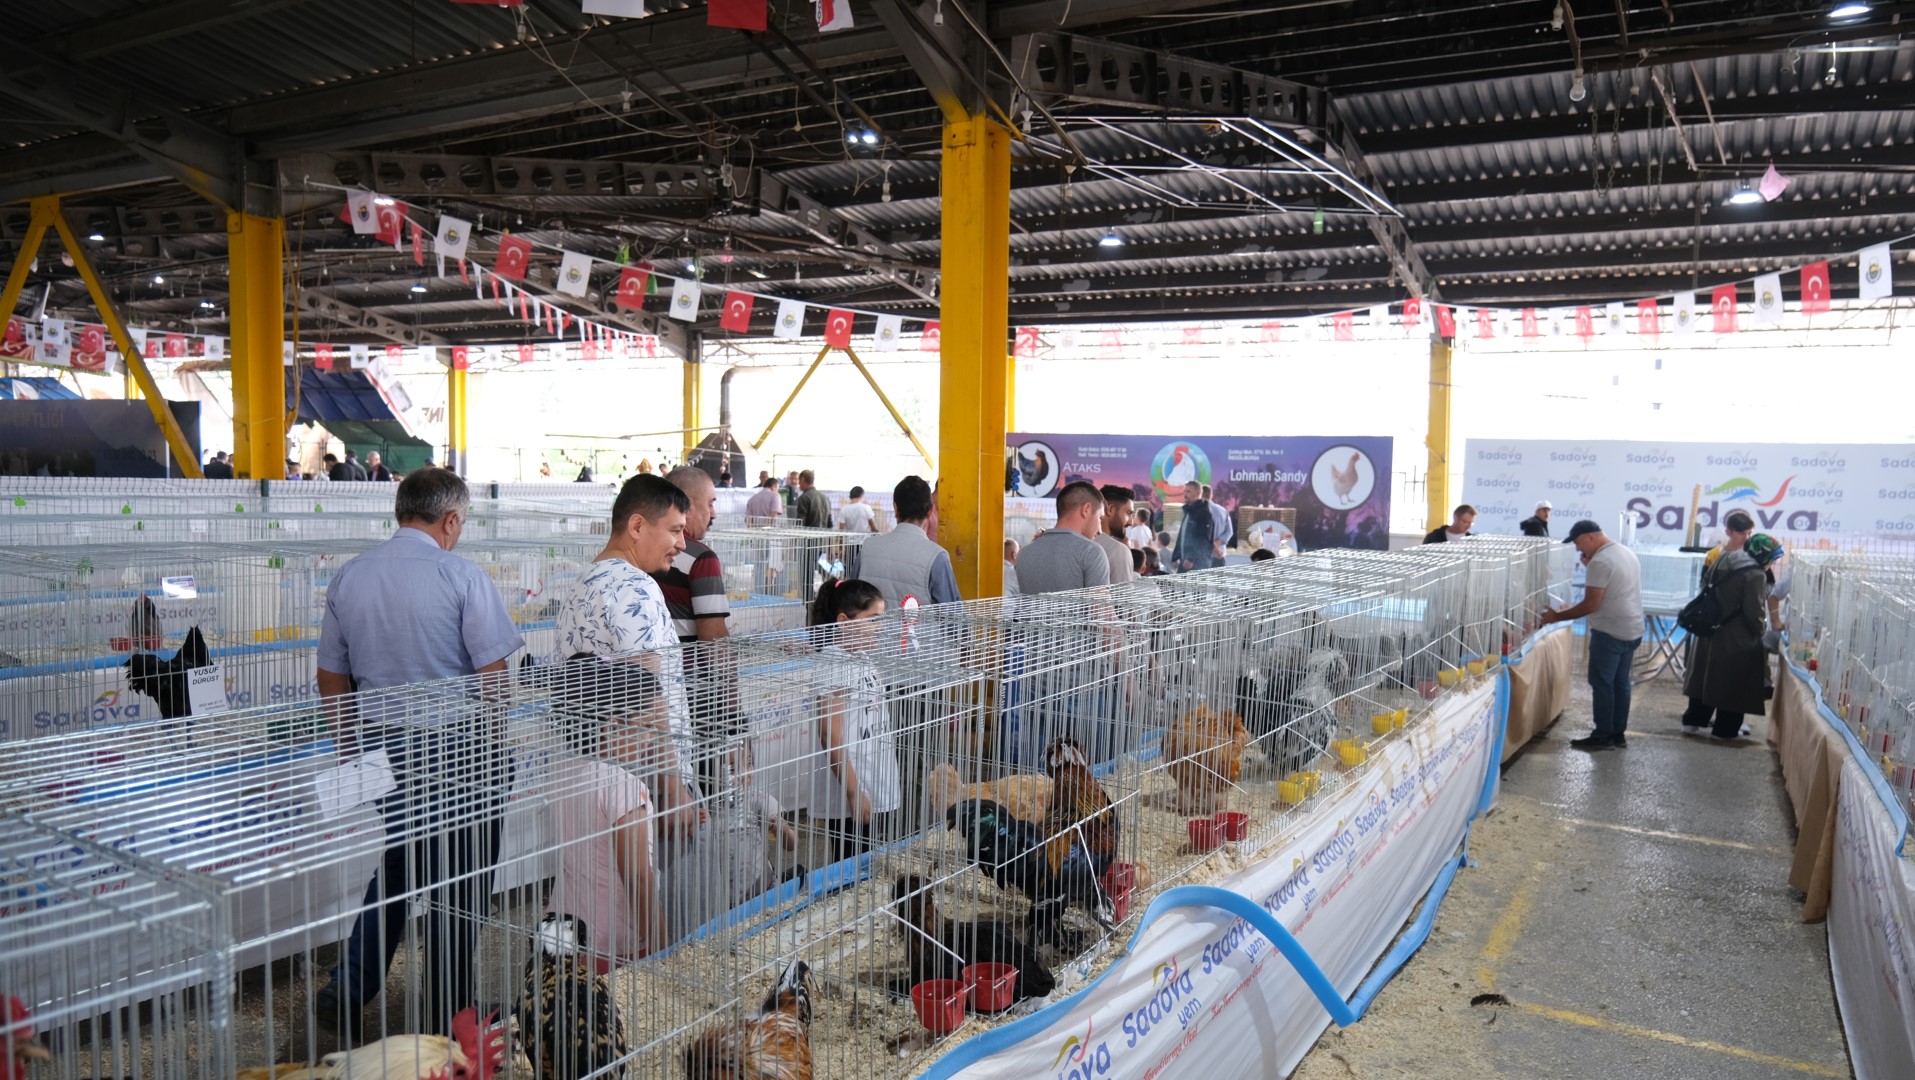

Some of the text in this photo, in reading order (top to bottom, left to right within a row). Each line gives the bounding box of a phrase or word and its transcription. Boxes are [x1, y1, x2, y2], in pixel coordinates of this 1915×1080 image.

[1478, 450, 1522, 461] Sadova
[1550, 451, 1596, 462] Sadova
[1626, 453, 1675, 464] Sadova
[1706, 455, 1758, 466] Sadova
[1791, 456, 1846, 468] Sadova
[1230, 469, 1307, 485] Lohman Sandy
[1476, 478, 1520, 488] Sadova
[1548, 479, 1595, 490] Sadova
[1624, 482, 1673, 493] Sadova
[1789, 487, 1843, 499] Sadova
[193, 666, 219, 677] YUSUF
[192, 674, 220, 686] DÜRÜST
[34, 702, 141, 730] Sadova
[1355, 799, 1387, 837] Sadova
[1313, 829, 1354, 873] Sadova
[1301, 888, 1317, 911] yem
[1245, 937, 1266, 964] yem
[1122, 968, 1194, 1048] Sadova
[1177, 996, 1202, 1030] yem
